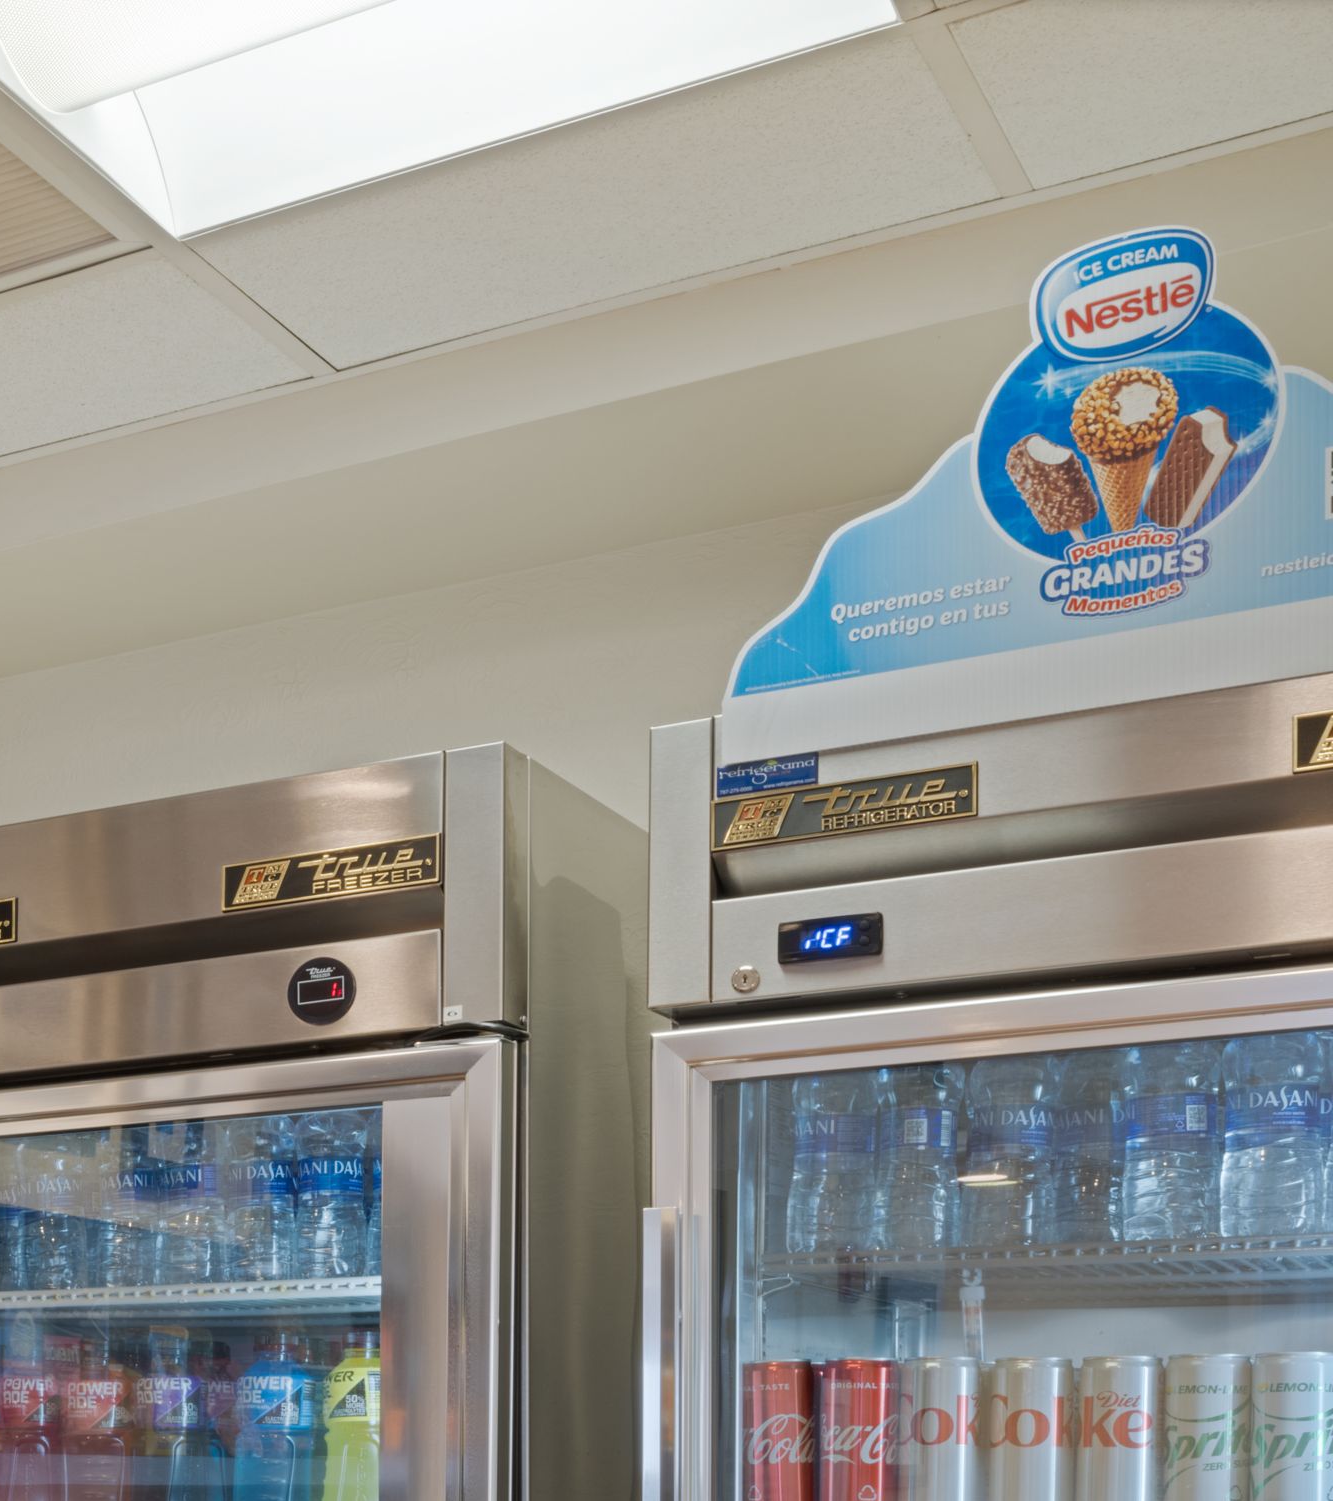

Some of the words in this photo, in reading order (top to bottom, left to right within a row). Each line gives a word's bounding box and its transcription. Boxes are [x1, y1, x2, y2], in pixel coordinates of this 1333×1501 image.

[1073, 259, 1104, 285] ICE
[1106, 243, 1179, 275] CREAM
[1064, 274, 1195, 339] Nestlé
[1070, 529, 1177, 563] Pequeños
[1044, 543, 1205, 598] GRANDES
[831, 588, 944, 624] Queremos
[949, 575, 1011, 599] estar
[1066, 580, 1181, 614] Momentos
[848, 611, 934, 642] contigo
[940, 607, 967, 626] en
[973, 601, 1010, 620] tus
[718, 757, 815, 784] refrigerama
[821, 800, 956, 831] REFRIGERATOR
[312, 867, 422, 893] FREEZER
[68, 1381, 123, 1398] POWER
[238, 1376, 292, 1392] POWER
[760, 1382, 790, 1391] TASTE
[1096, 1391, 1141, 1408] Diet
